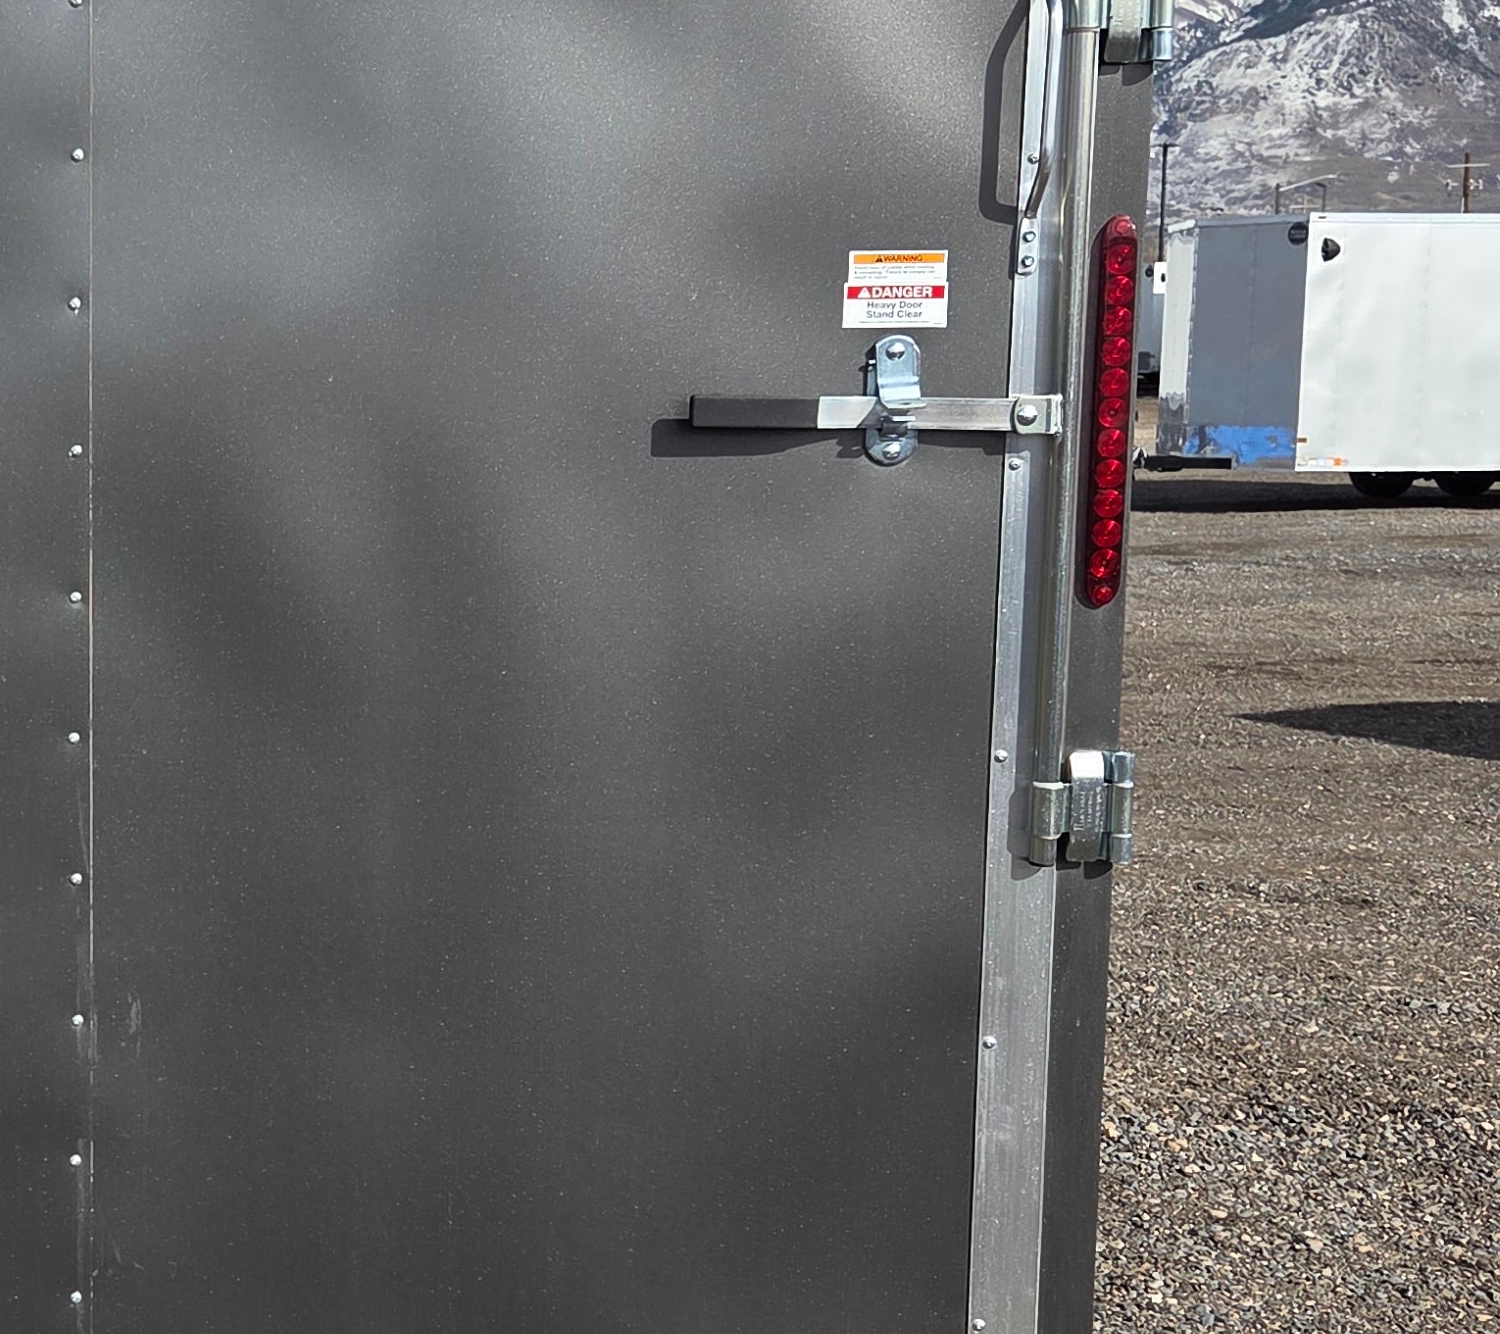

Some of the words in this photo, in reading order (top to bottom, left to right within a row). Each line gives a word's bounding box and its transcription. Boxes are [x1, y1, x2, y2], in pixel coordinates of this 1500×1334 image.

[883, 254, 923, 262] WARNING
[871, 286, 933, 298] DANGER
[867, 301, 896, 310] Heavy
[899, 301, 923, 309] Door
[866, 310, 895, 319] Stand
[897, 310, 923, 318] Clear
